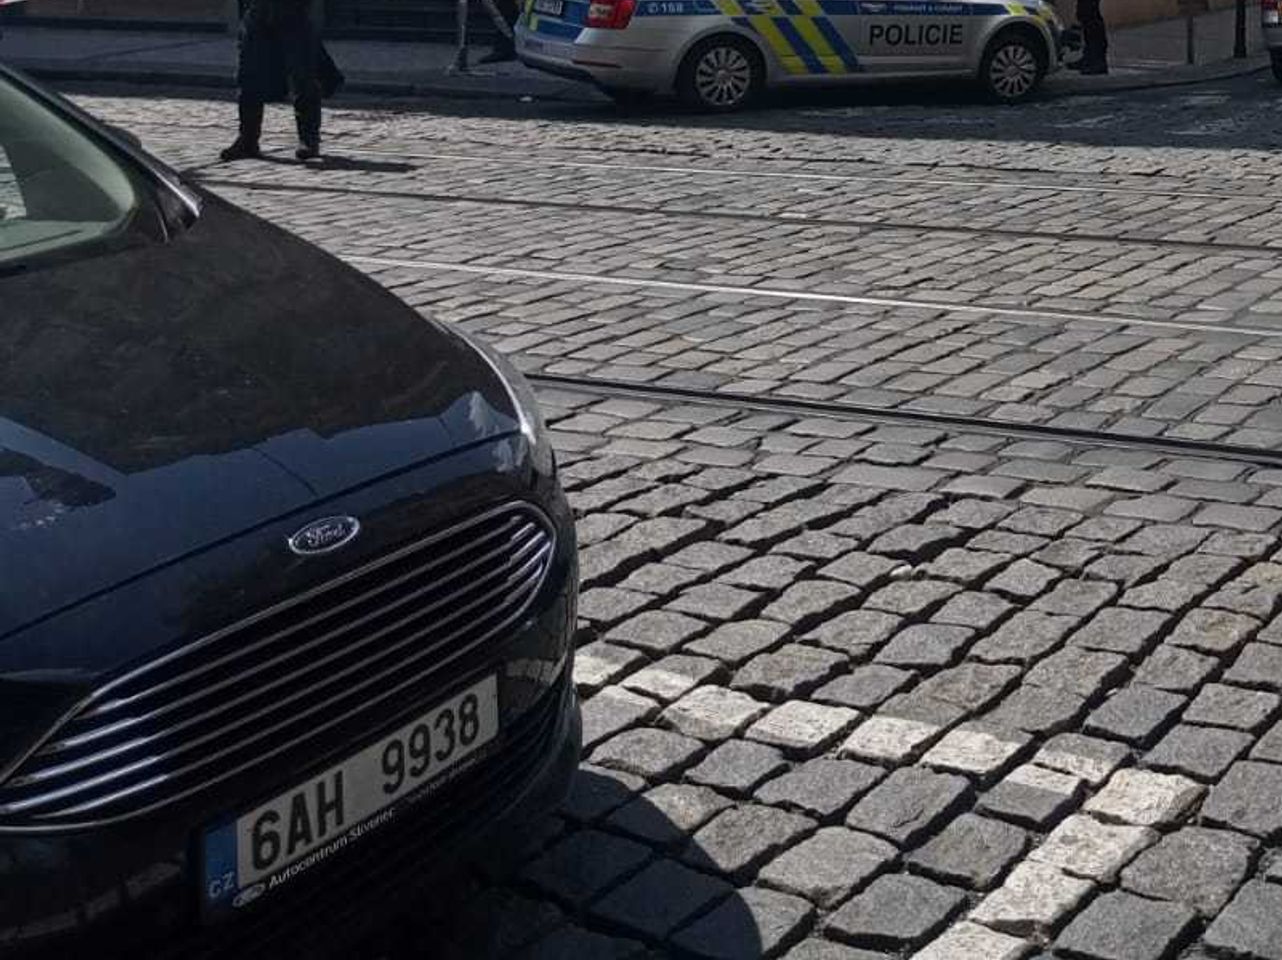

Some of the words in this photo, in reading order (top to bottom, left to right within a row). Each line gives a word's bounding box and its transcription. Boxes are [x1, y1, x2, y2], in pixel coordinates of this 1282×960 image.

[869, 24, 963, 45] POLICIE
[250, 770, 344, 872] 6AH
[381, 694, 480, 795] 9938
[208, 869, 235, 899] CZ
